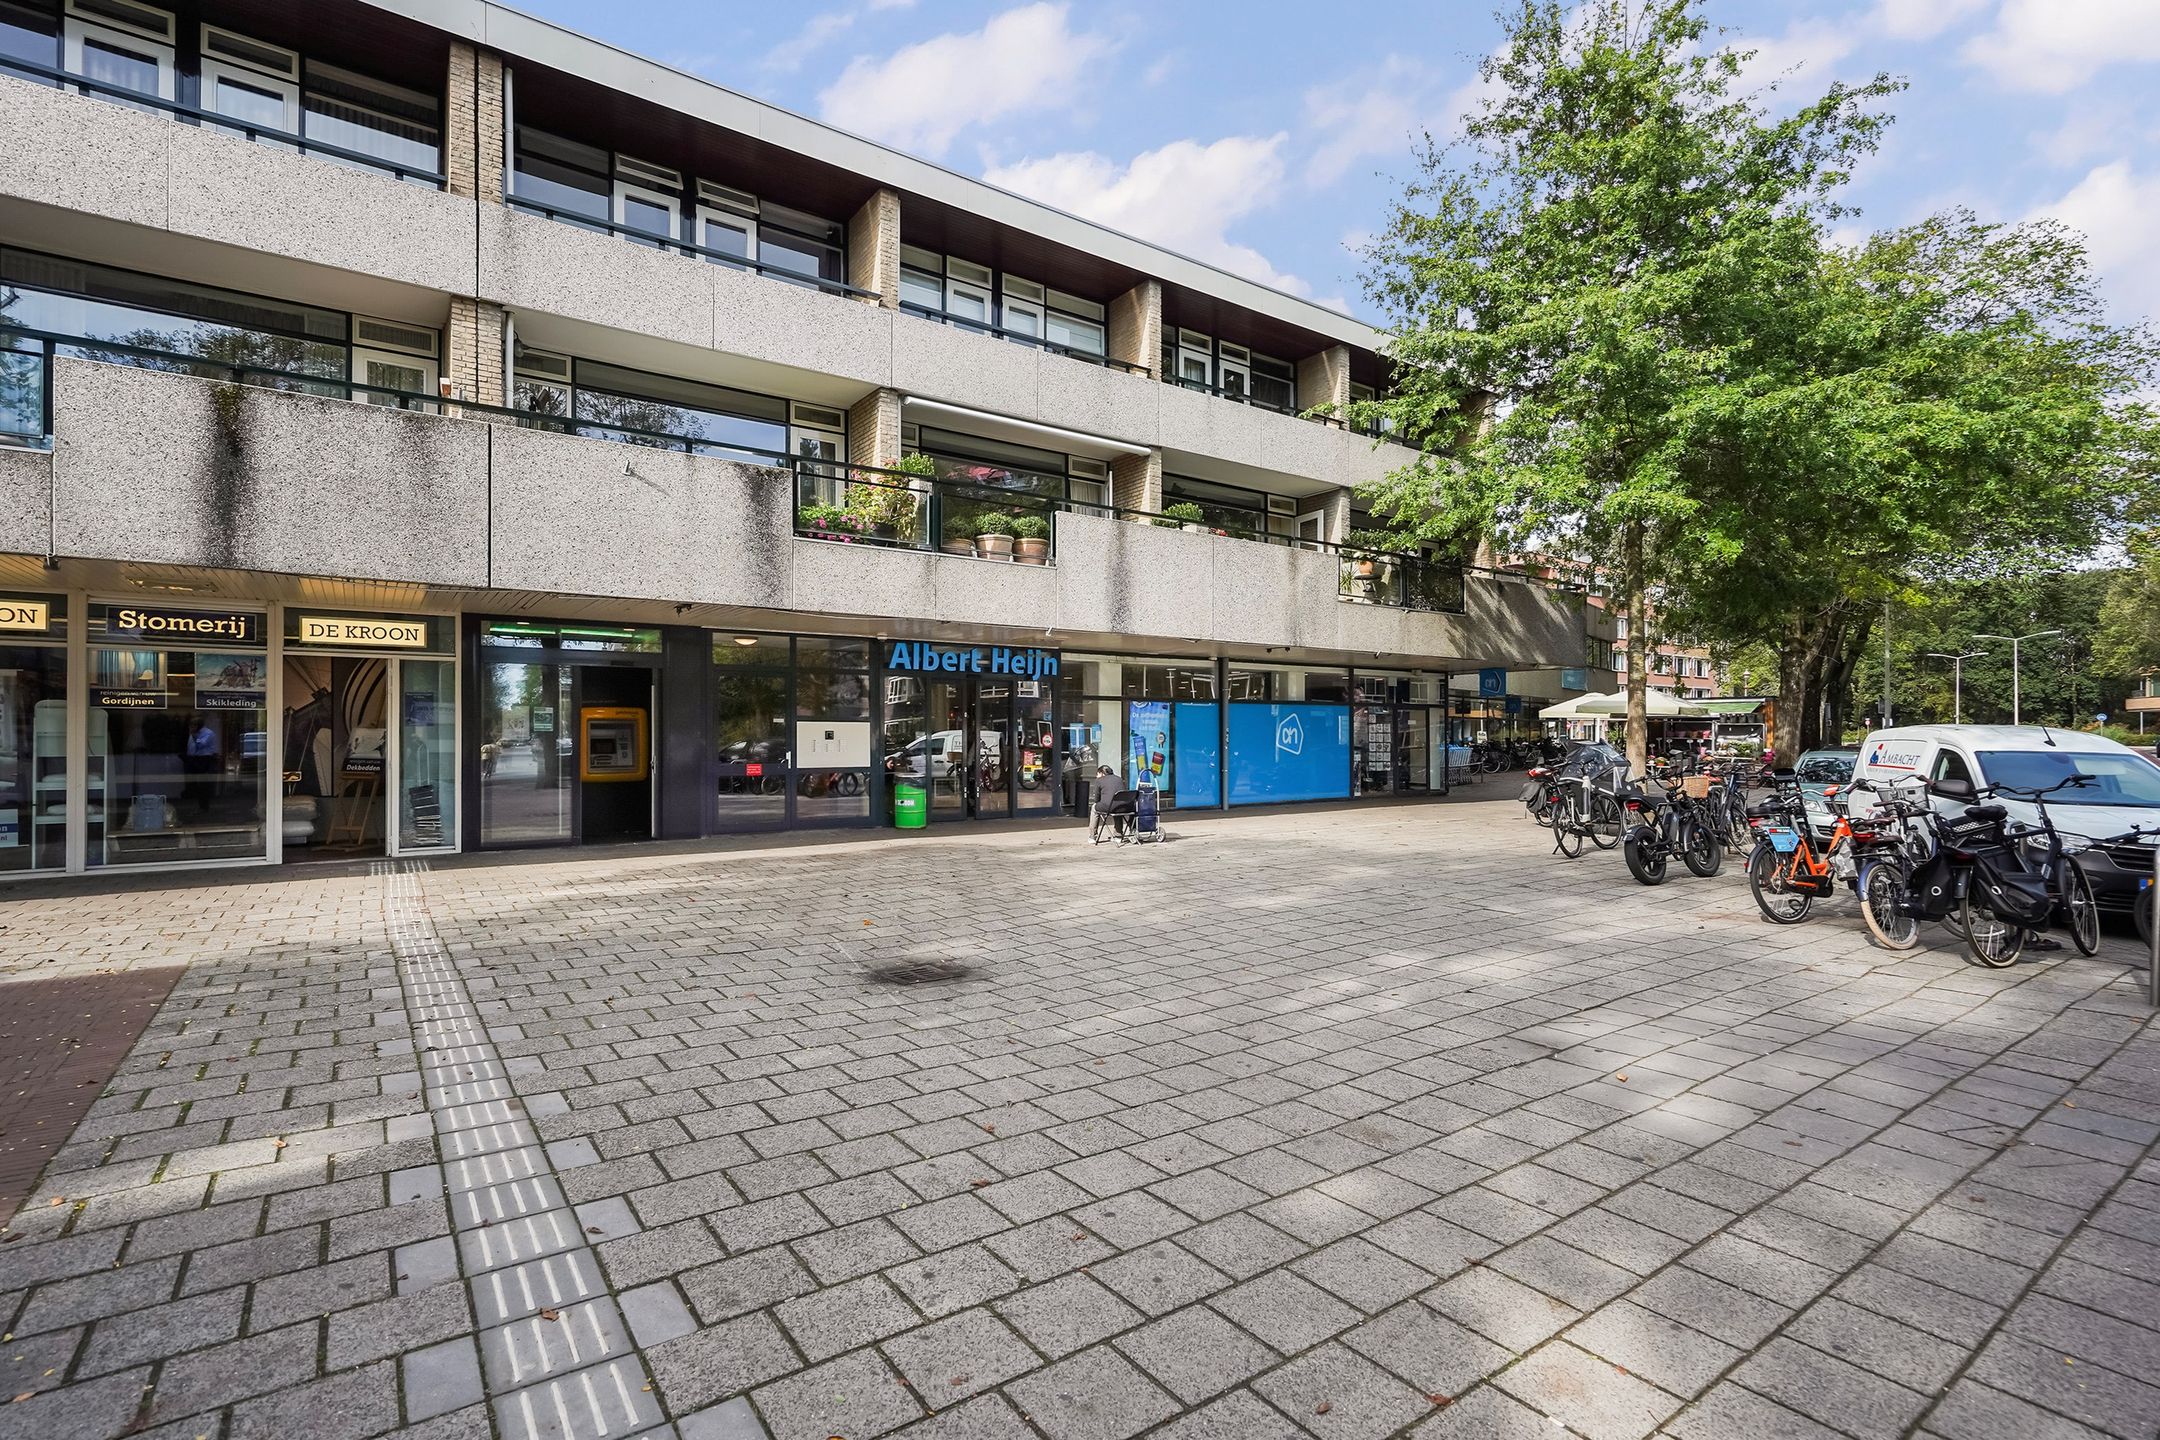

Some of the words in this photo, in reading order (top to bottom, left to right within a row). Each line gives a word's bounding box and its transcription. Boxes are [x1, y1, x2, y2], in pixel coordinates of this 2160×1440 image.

[118, 609, 246, 639] Stomerij
[309, 623, 339, 638] DE
[345, 625, 420, 641] KROON
[889, 641, 982, 672] Albert
[991, 647, 1058, 681] Heijn
[101, 696, 155, 706] Gordijnen
[206, 699, 257, 708] Skikleding
